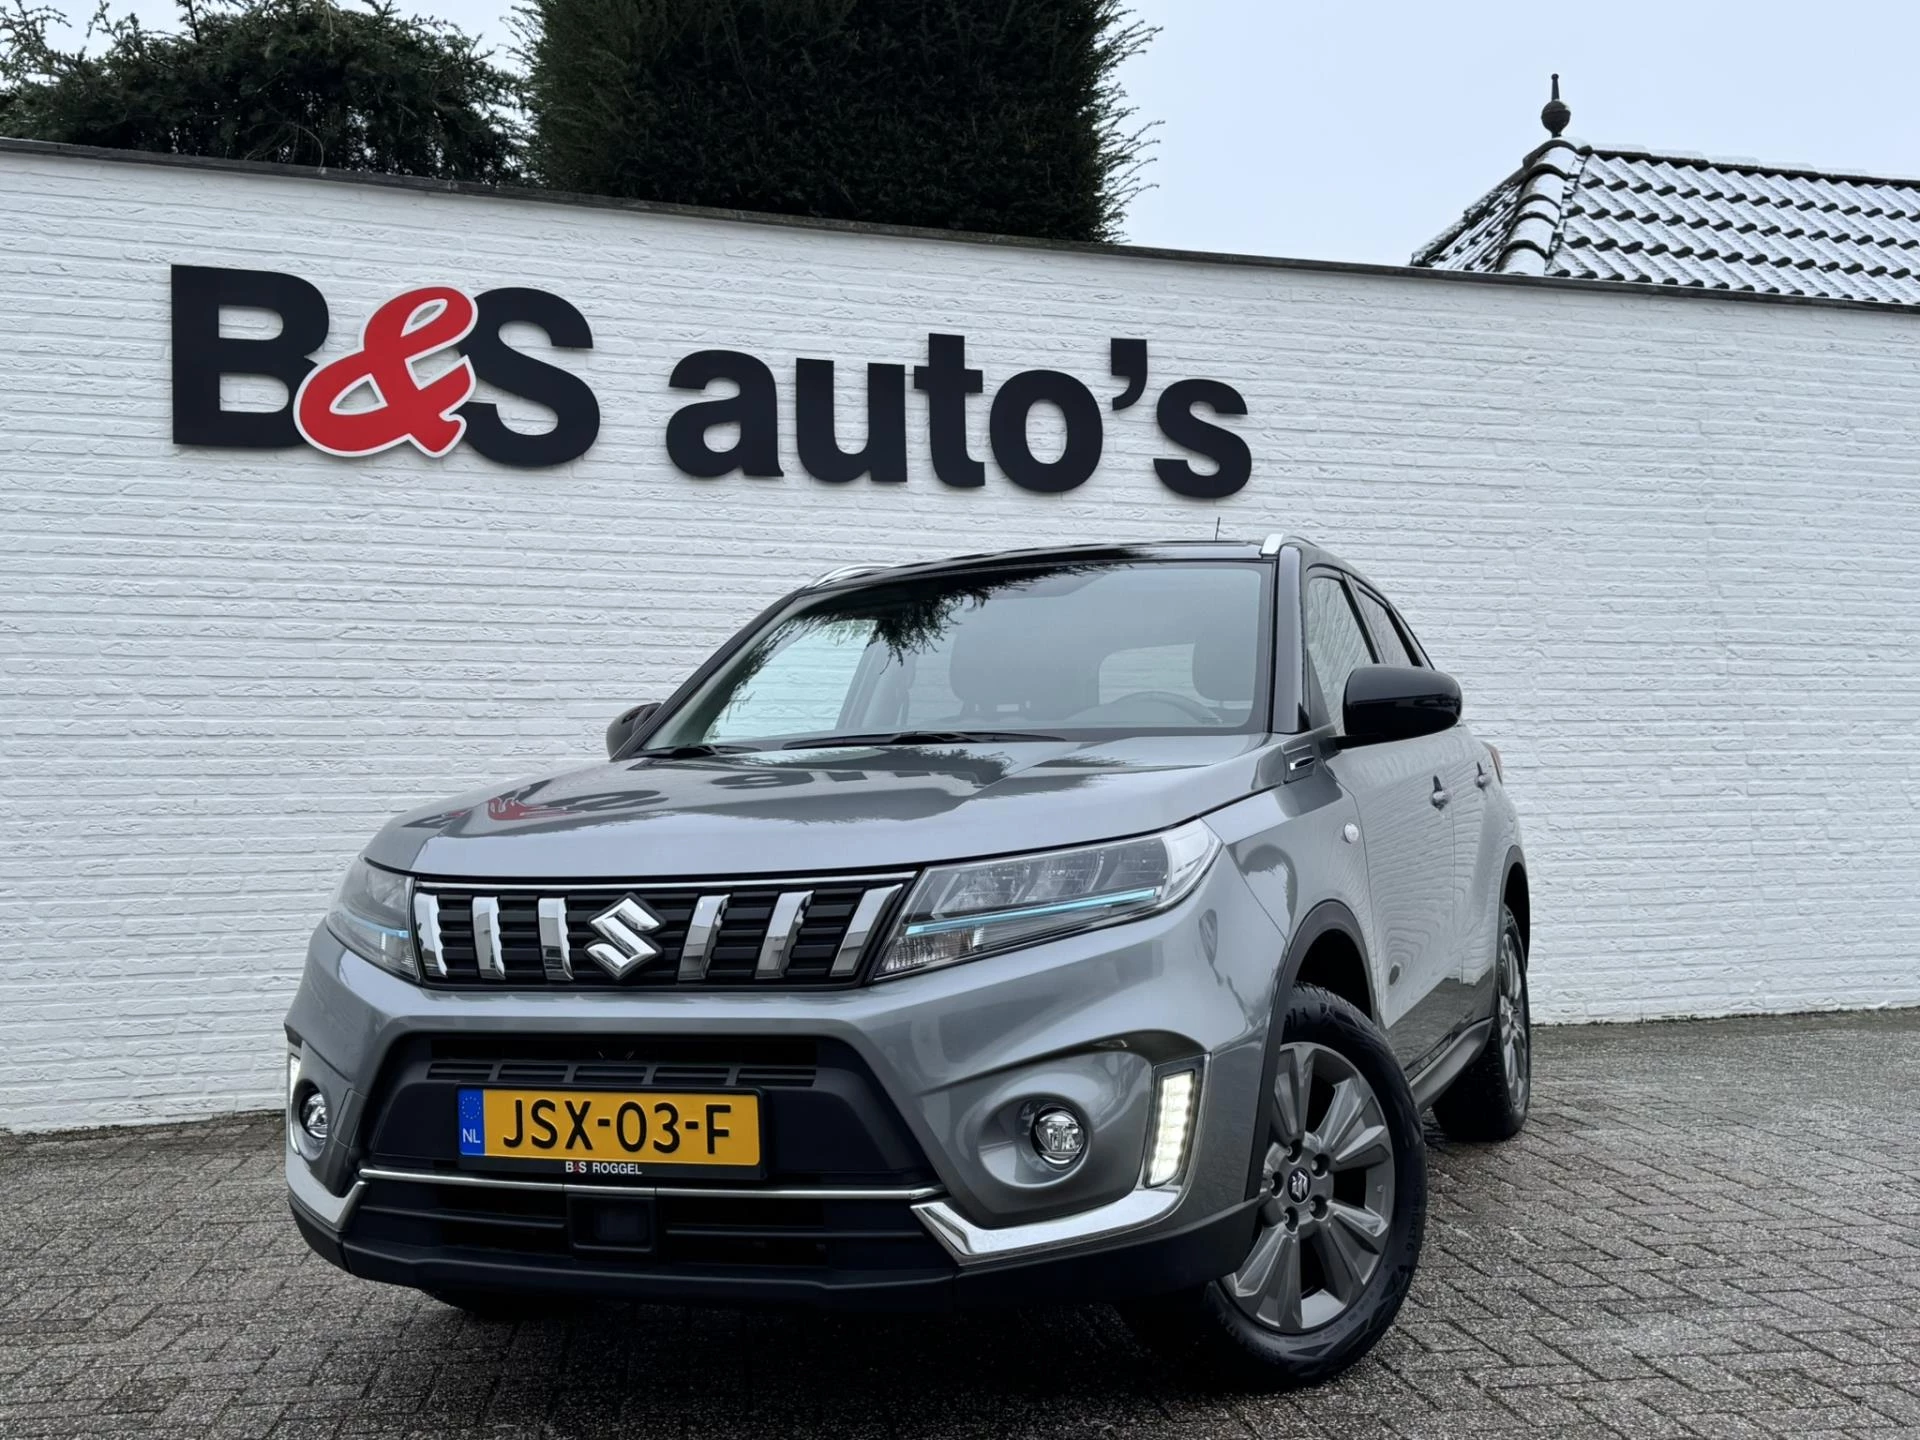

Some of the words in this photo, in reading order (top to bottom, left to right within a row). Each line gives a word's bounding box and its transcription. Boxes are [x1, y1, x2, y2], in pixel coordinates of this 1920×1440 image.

[171, 264, 600, 467] B&S
[666, 333, 1252, 499] auto's
[462, 1128, 481, 1144] NL
[503, 1098, 731, 1154] JSX-03-F
[592, 1162, 642, 1175] ROGGEL
